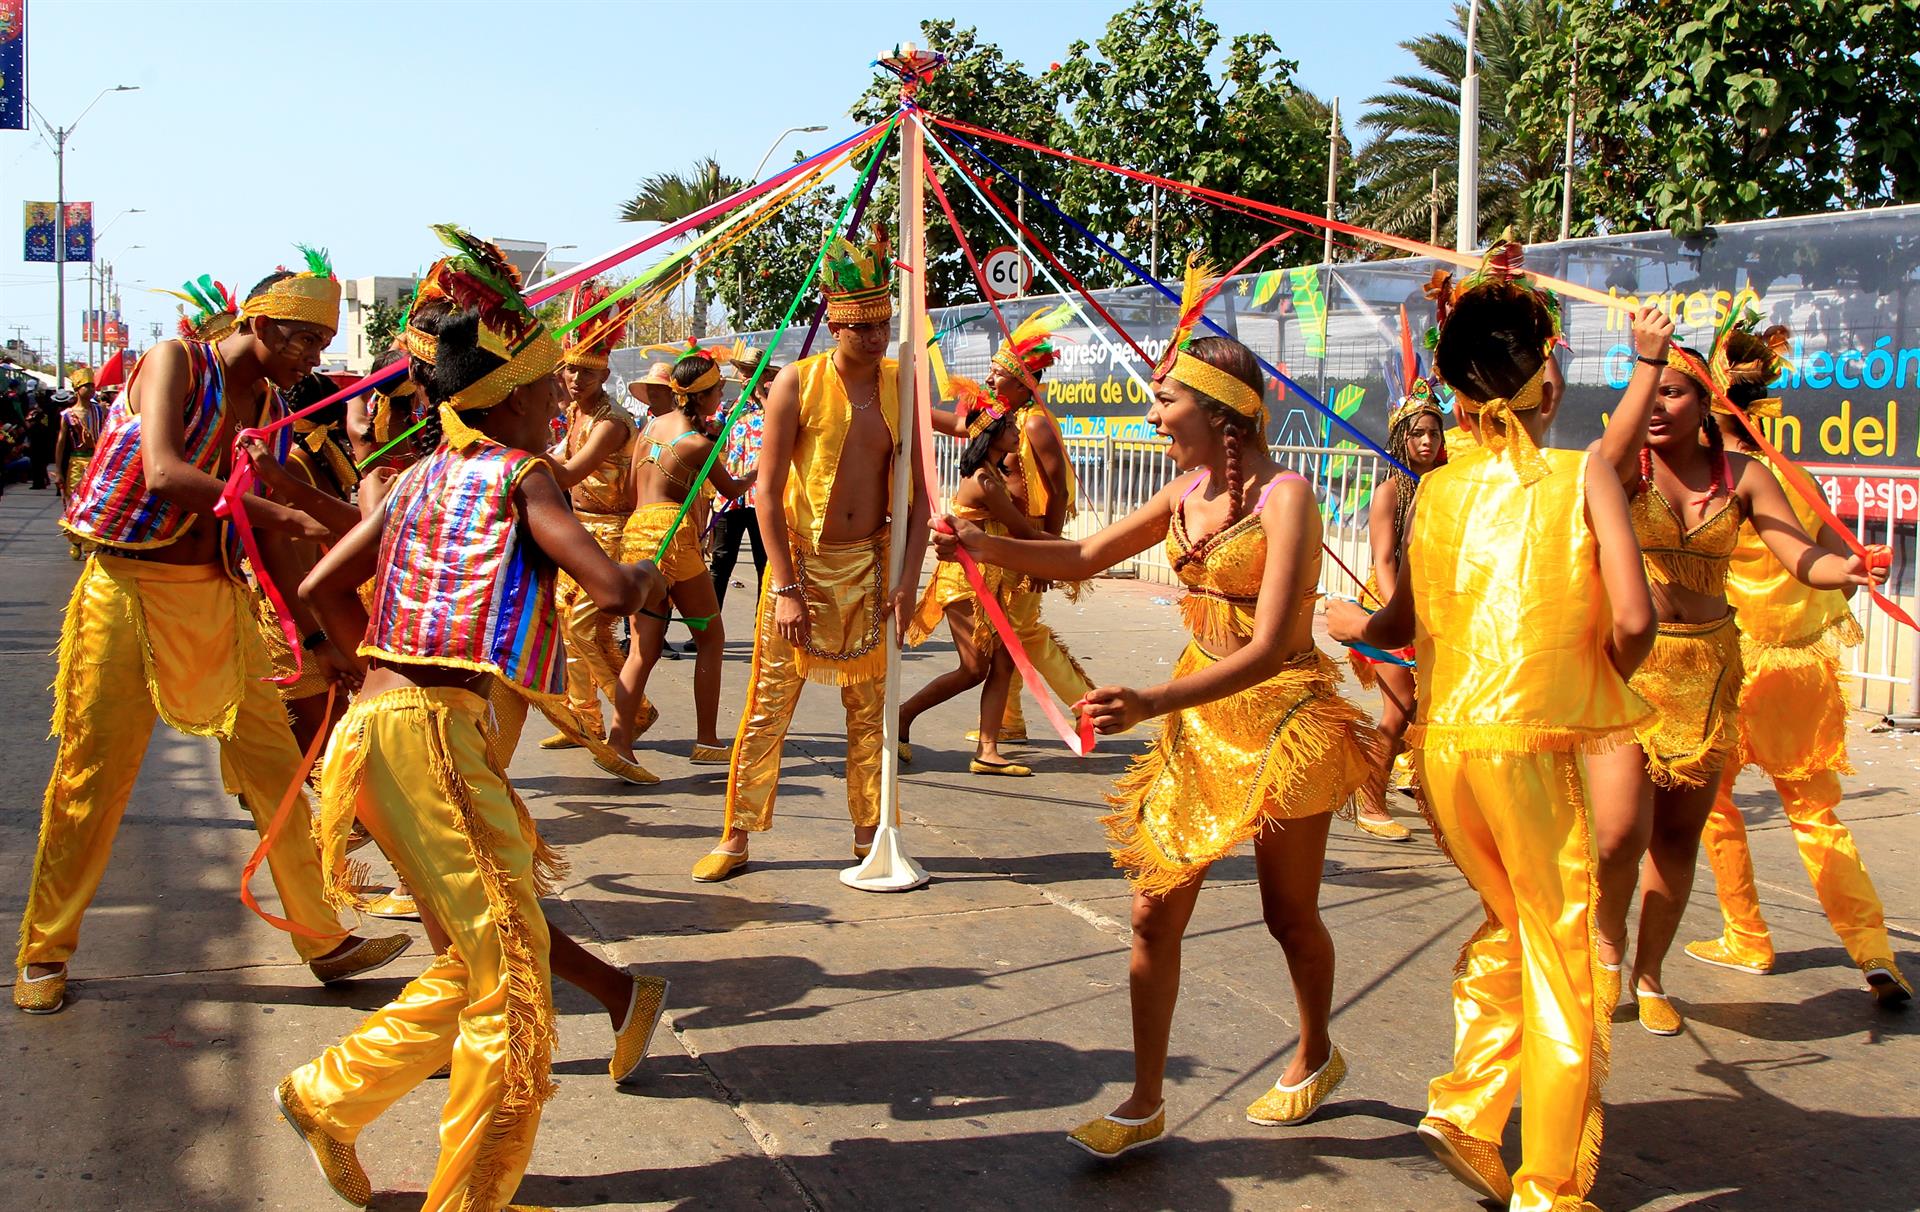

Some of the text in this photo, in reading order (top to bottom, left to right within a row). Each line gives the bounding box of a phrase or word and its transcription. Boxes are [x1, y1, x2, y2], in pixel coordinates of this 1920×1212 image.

[993, 260, 1020, 284] 60
[1047, 377, 1096, 404] Puerta
[1101, 374, 1123, 404] de
[1088, 415, 1106, 442] 78
[1820, 400, 1897, 458] del
